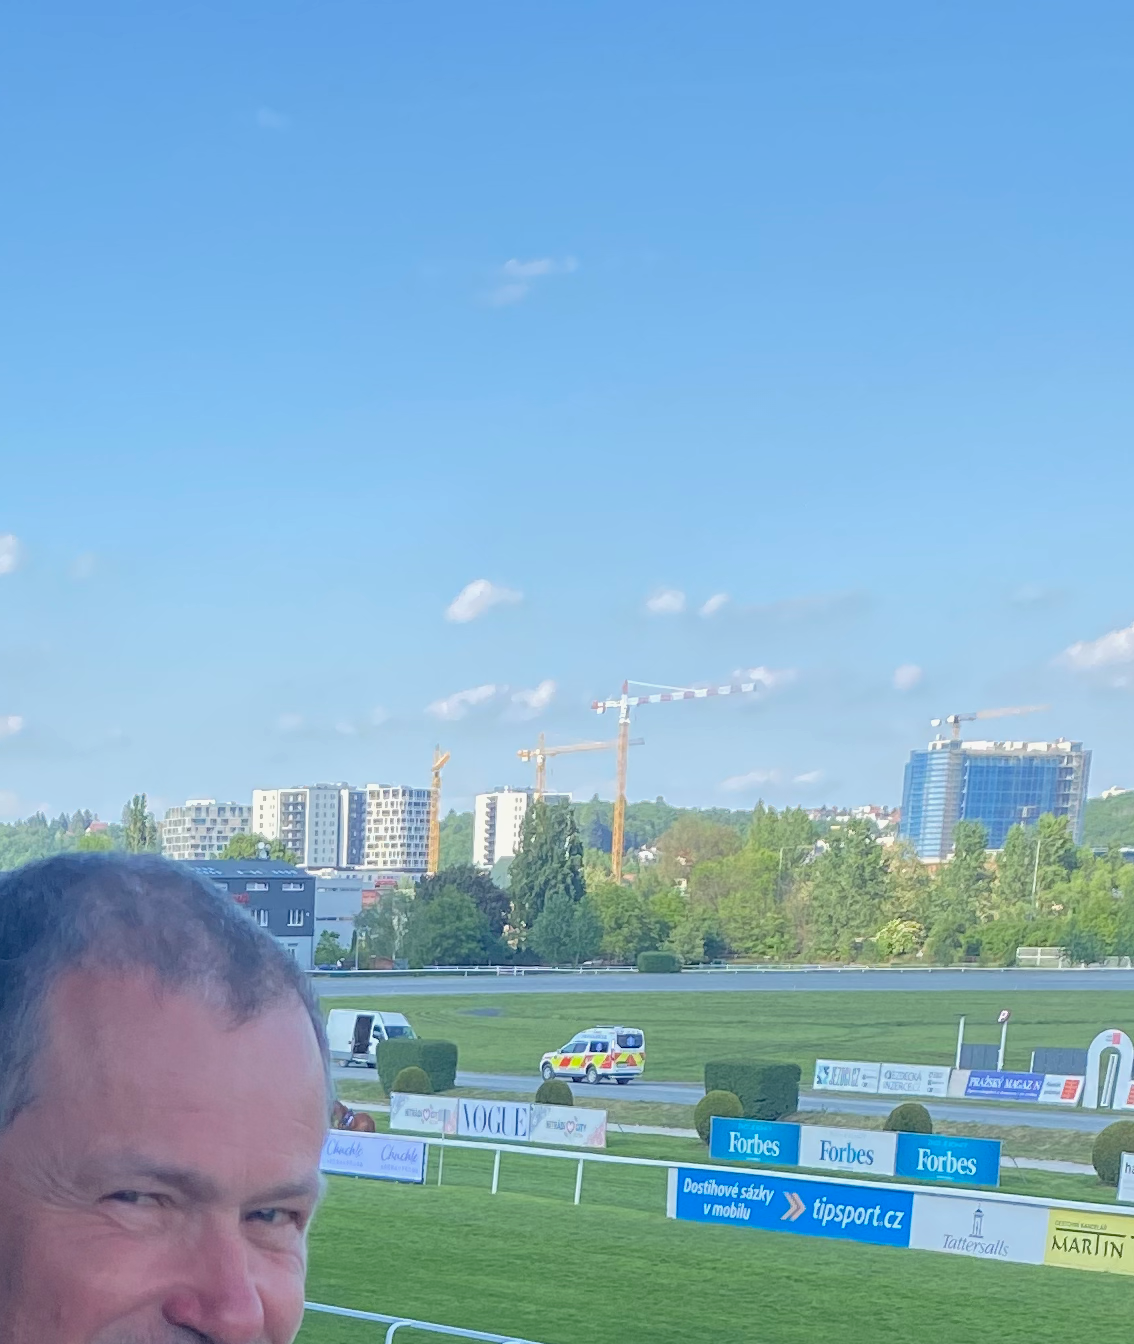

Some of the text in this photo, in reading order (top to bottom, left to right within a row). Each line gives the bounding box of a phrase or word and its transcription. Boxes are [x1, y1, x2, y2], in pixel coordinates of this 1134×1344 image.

[462, 1103, 527, 1137] VOGUE
[728, 1131, 780, 1156] Forbes
[819, 1139, 875, 1165] Forbes
[917, 1148, 977, 1175] Forbes
[683, 1177, 774, 1205] Dostihové sázky
[703, 1202, 751, 1220] v mobilu
[813, 1196, 905, 1229] tipsport.cz
[943, 1233, 1010, 1257] Tattersalls
[1051, 1229, 1126, 1259] MARTIN
